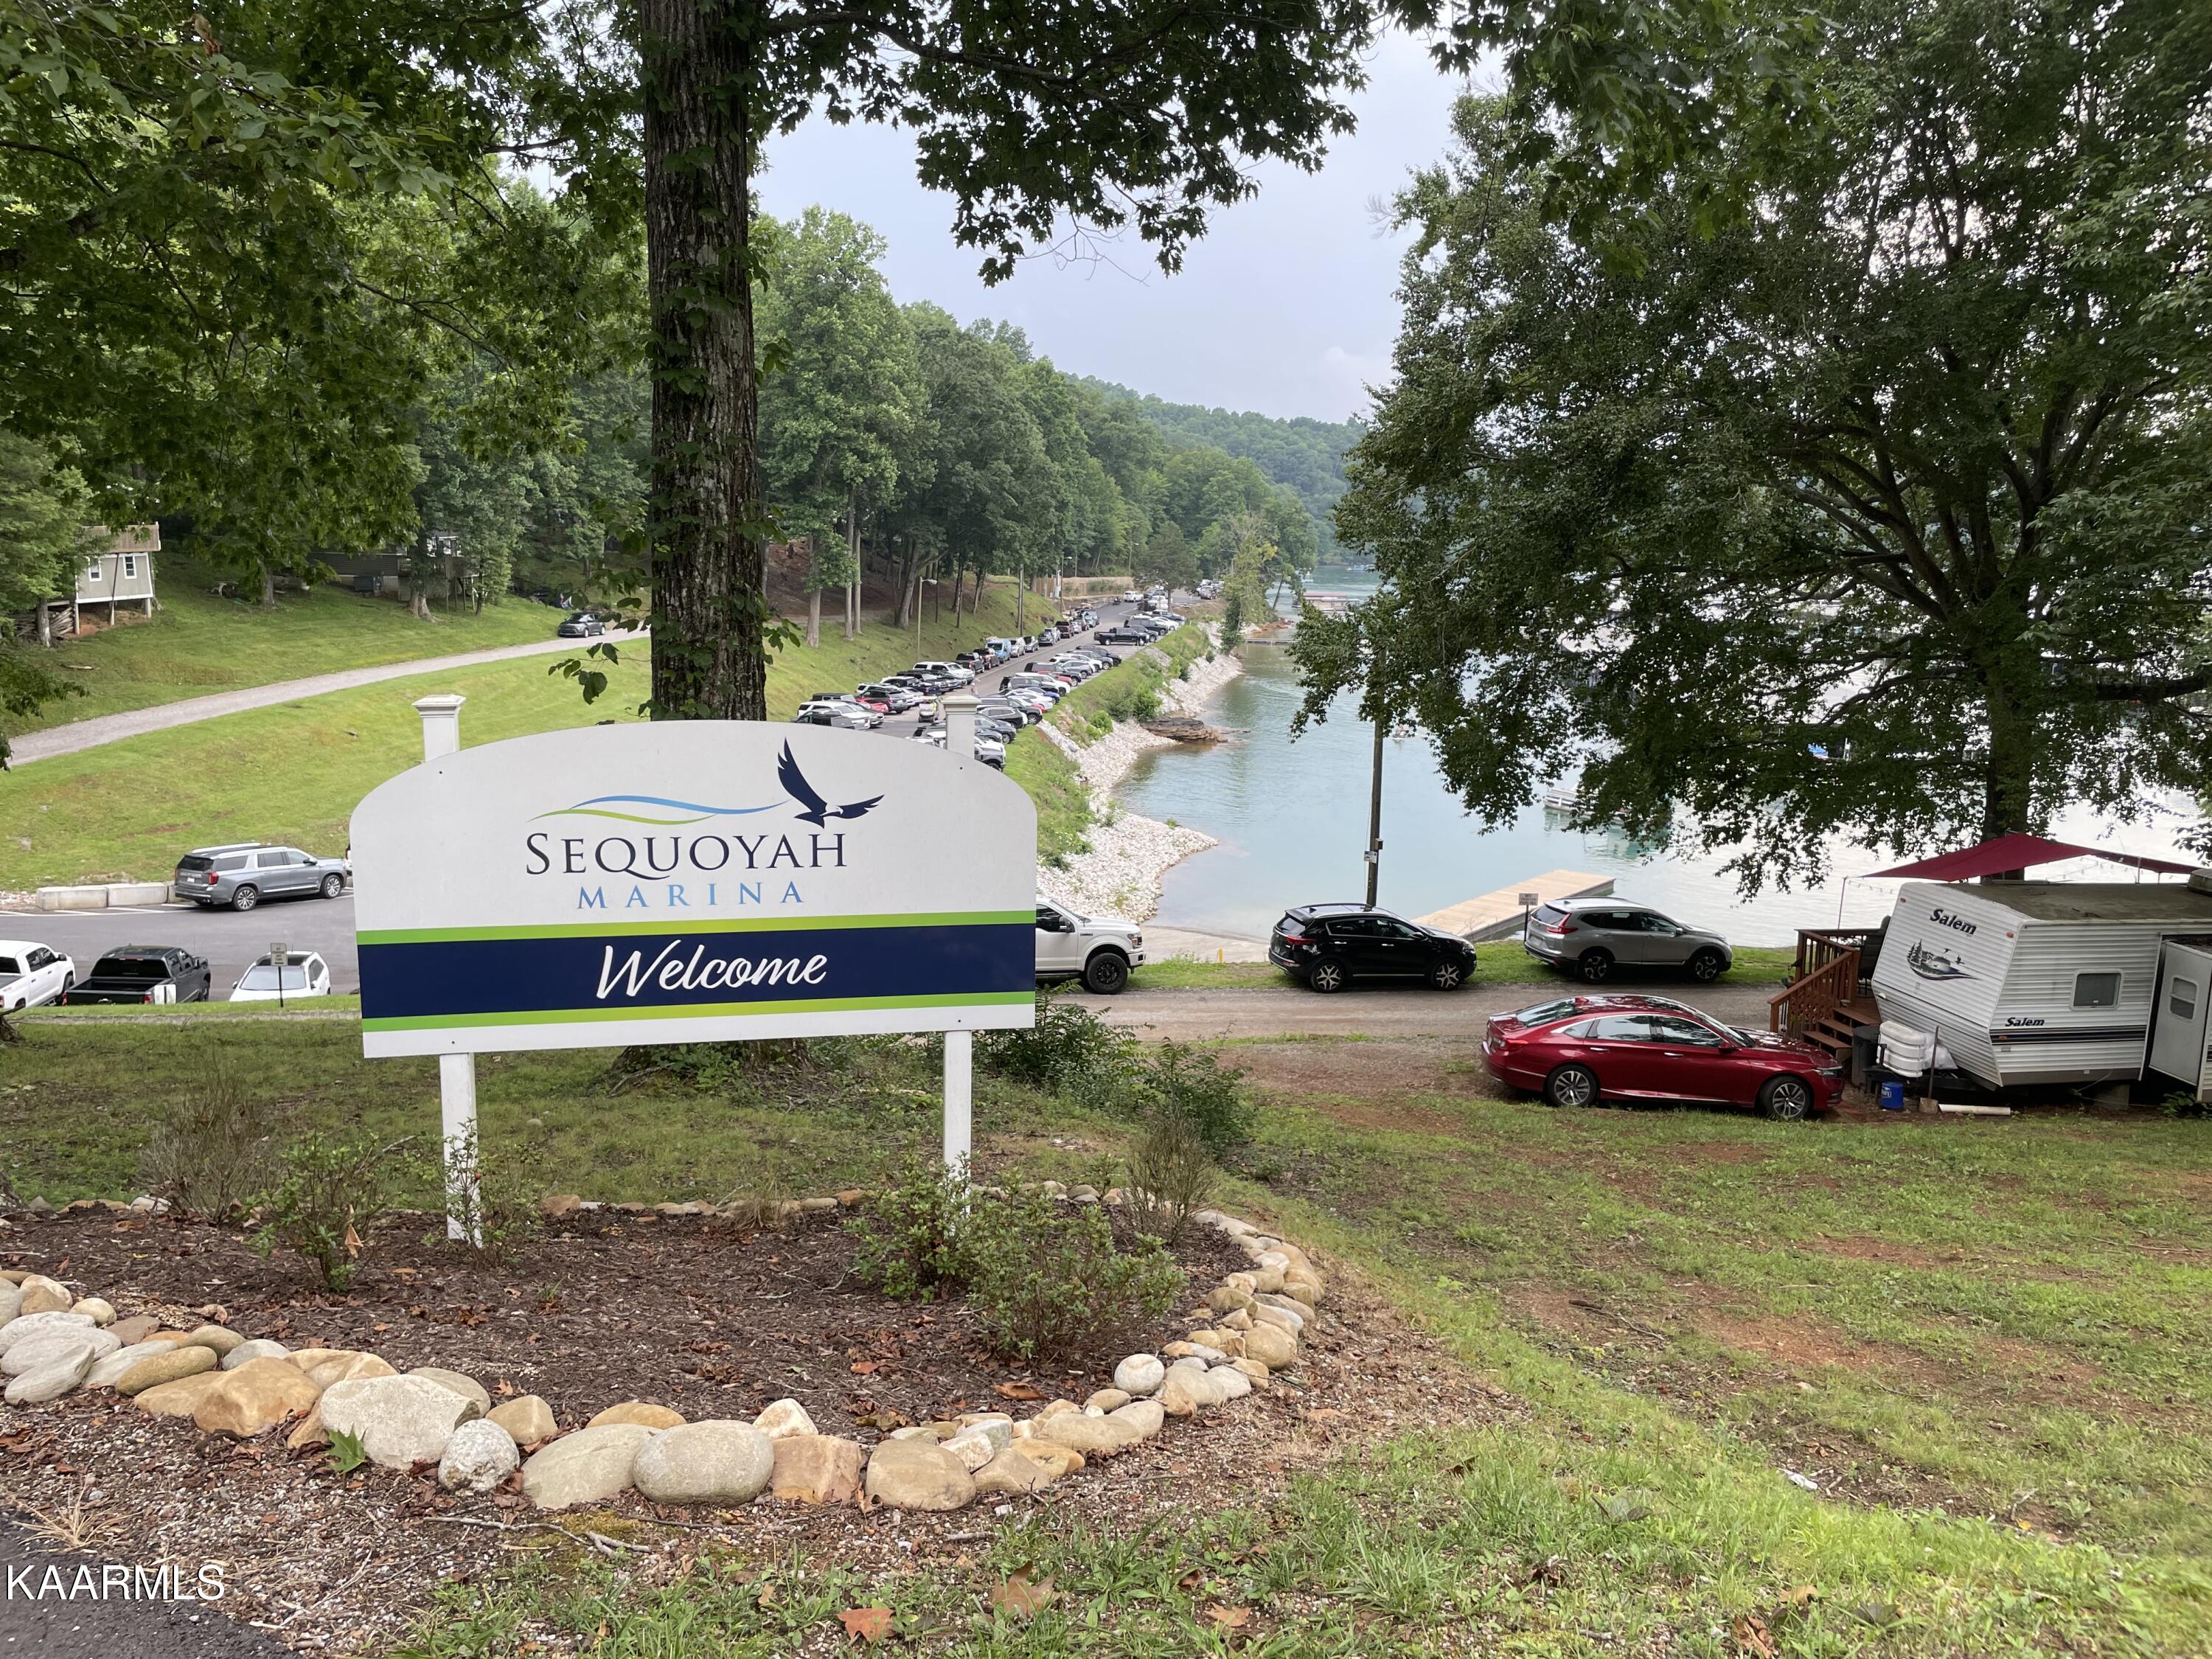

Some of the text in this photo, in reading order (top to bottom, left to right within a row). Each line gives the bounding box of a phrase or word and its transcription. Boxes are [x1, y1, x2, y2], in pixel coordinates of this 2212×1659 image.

[526, 832, 847, 880] SEQUOYAH
[577, 880, 804, 909] MARINA
[1930, 908, 1977, 935] Salem
[597, 939, 827, 999] Welcome
[2005, 1017, 2045, 1027] Salem
